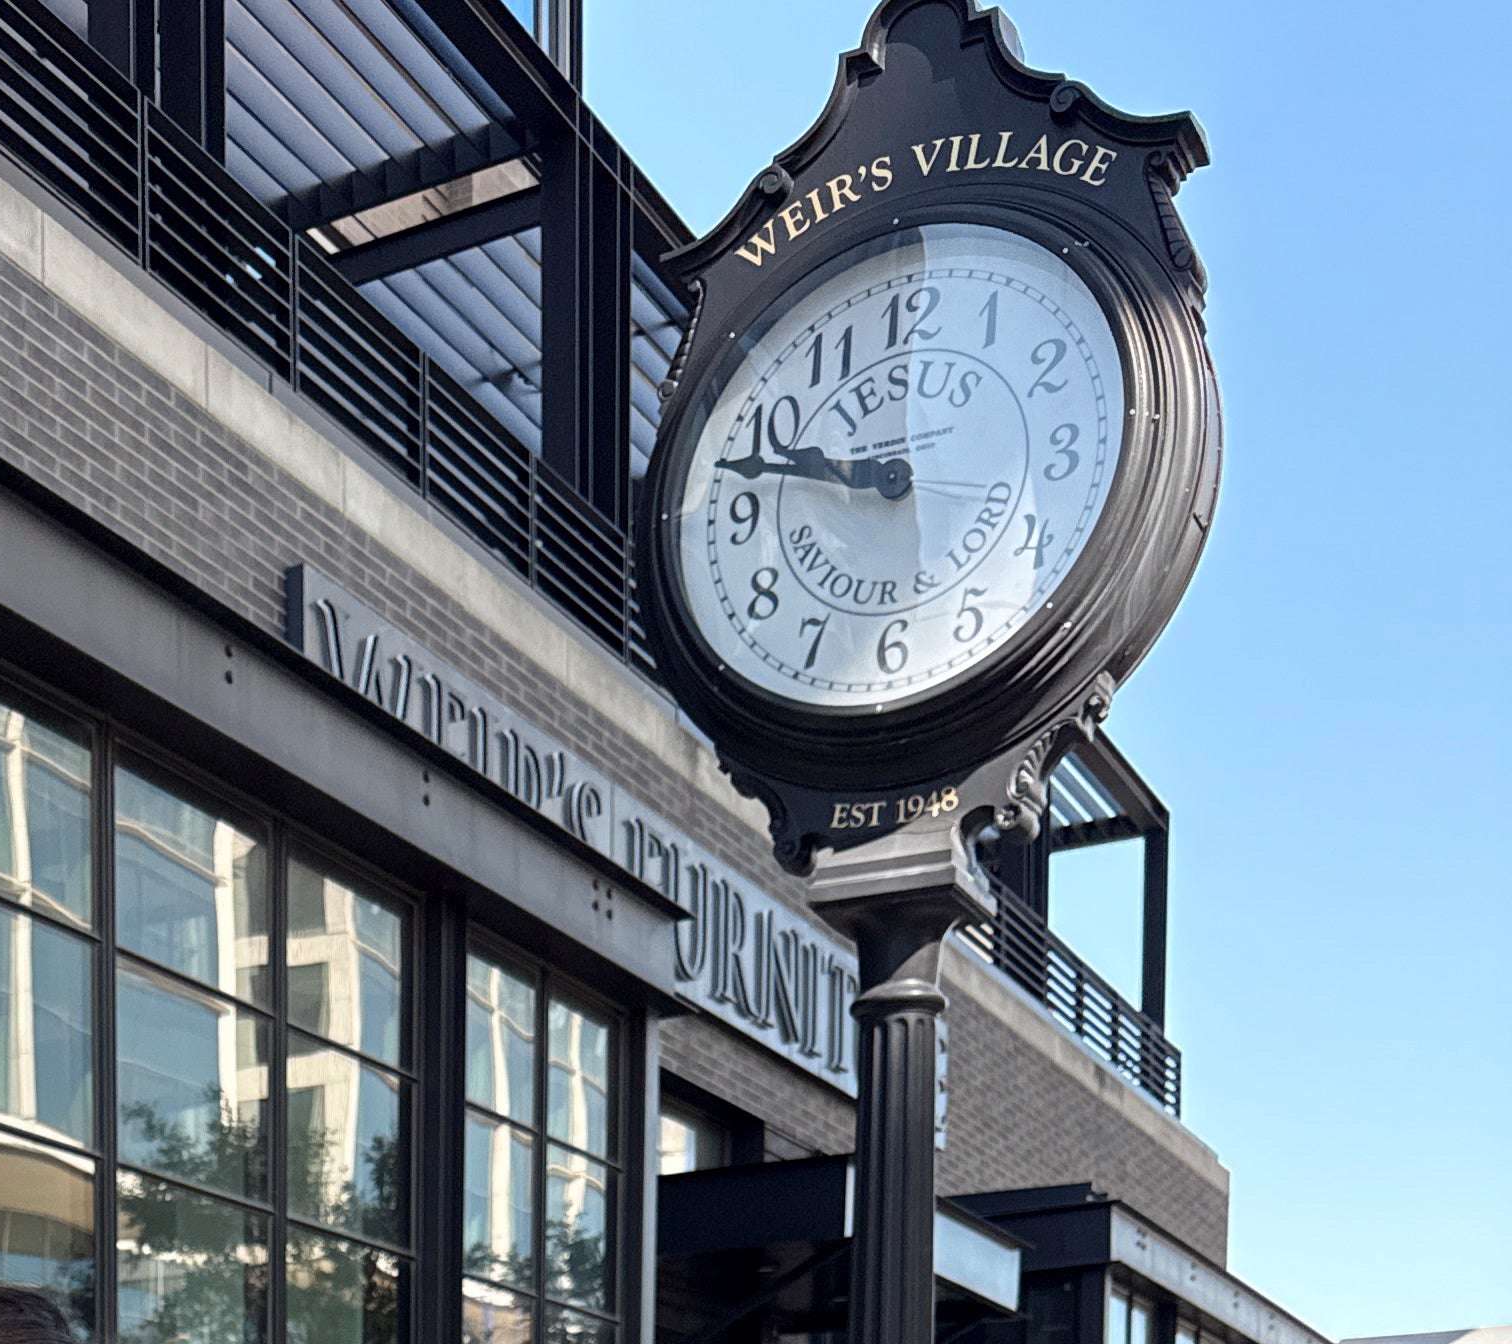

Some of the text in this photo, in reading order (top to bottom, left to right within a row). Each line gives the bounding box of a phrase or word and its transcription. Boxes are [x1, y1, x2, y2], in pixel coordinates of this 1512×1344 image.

[734, 131, 1118, 268] WEIR'S VILLAGE
[881, 286, 942, 350] 12
[978, 290, 999, 348] 1
[804, 325, 854, 389] 11
[1028, 338, 1068, 397] 2
[745, 395, 800, 454] 10
[828, 360, 982, 436] JESUS
[1043, 423, 1080, 481] 3
[729, 492, 760, 545] 9
[789, 481, 1012, 605] SAVIOUR & LORD
[1013, 513, 1053, 570] 4
[747, 567, 779, 620] 8
[953, 587, 987, 643] 5
[799, 613, 831, 669] 7
[876, 619, 908, 673] 6
[830, 786, 959, 829] EST 1948
